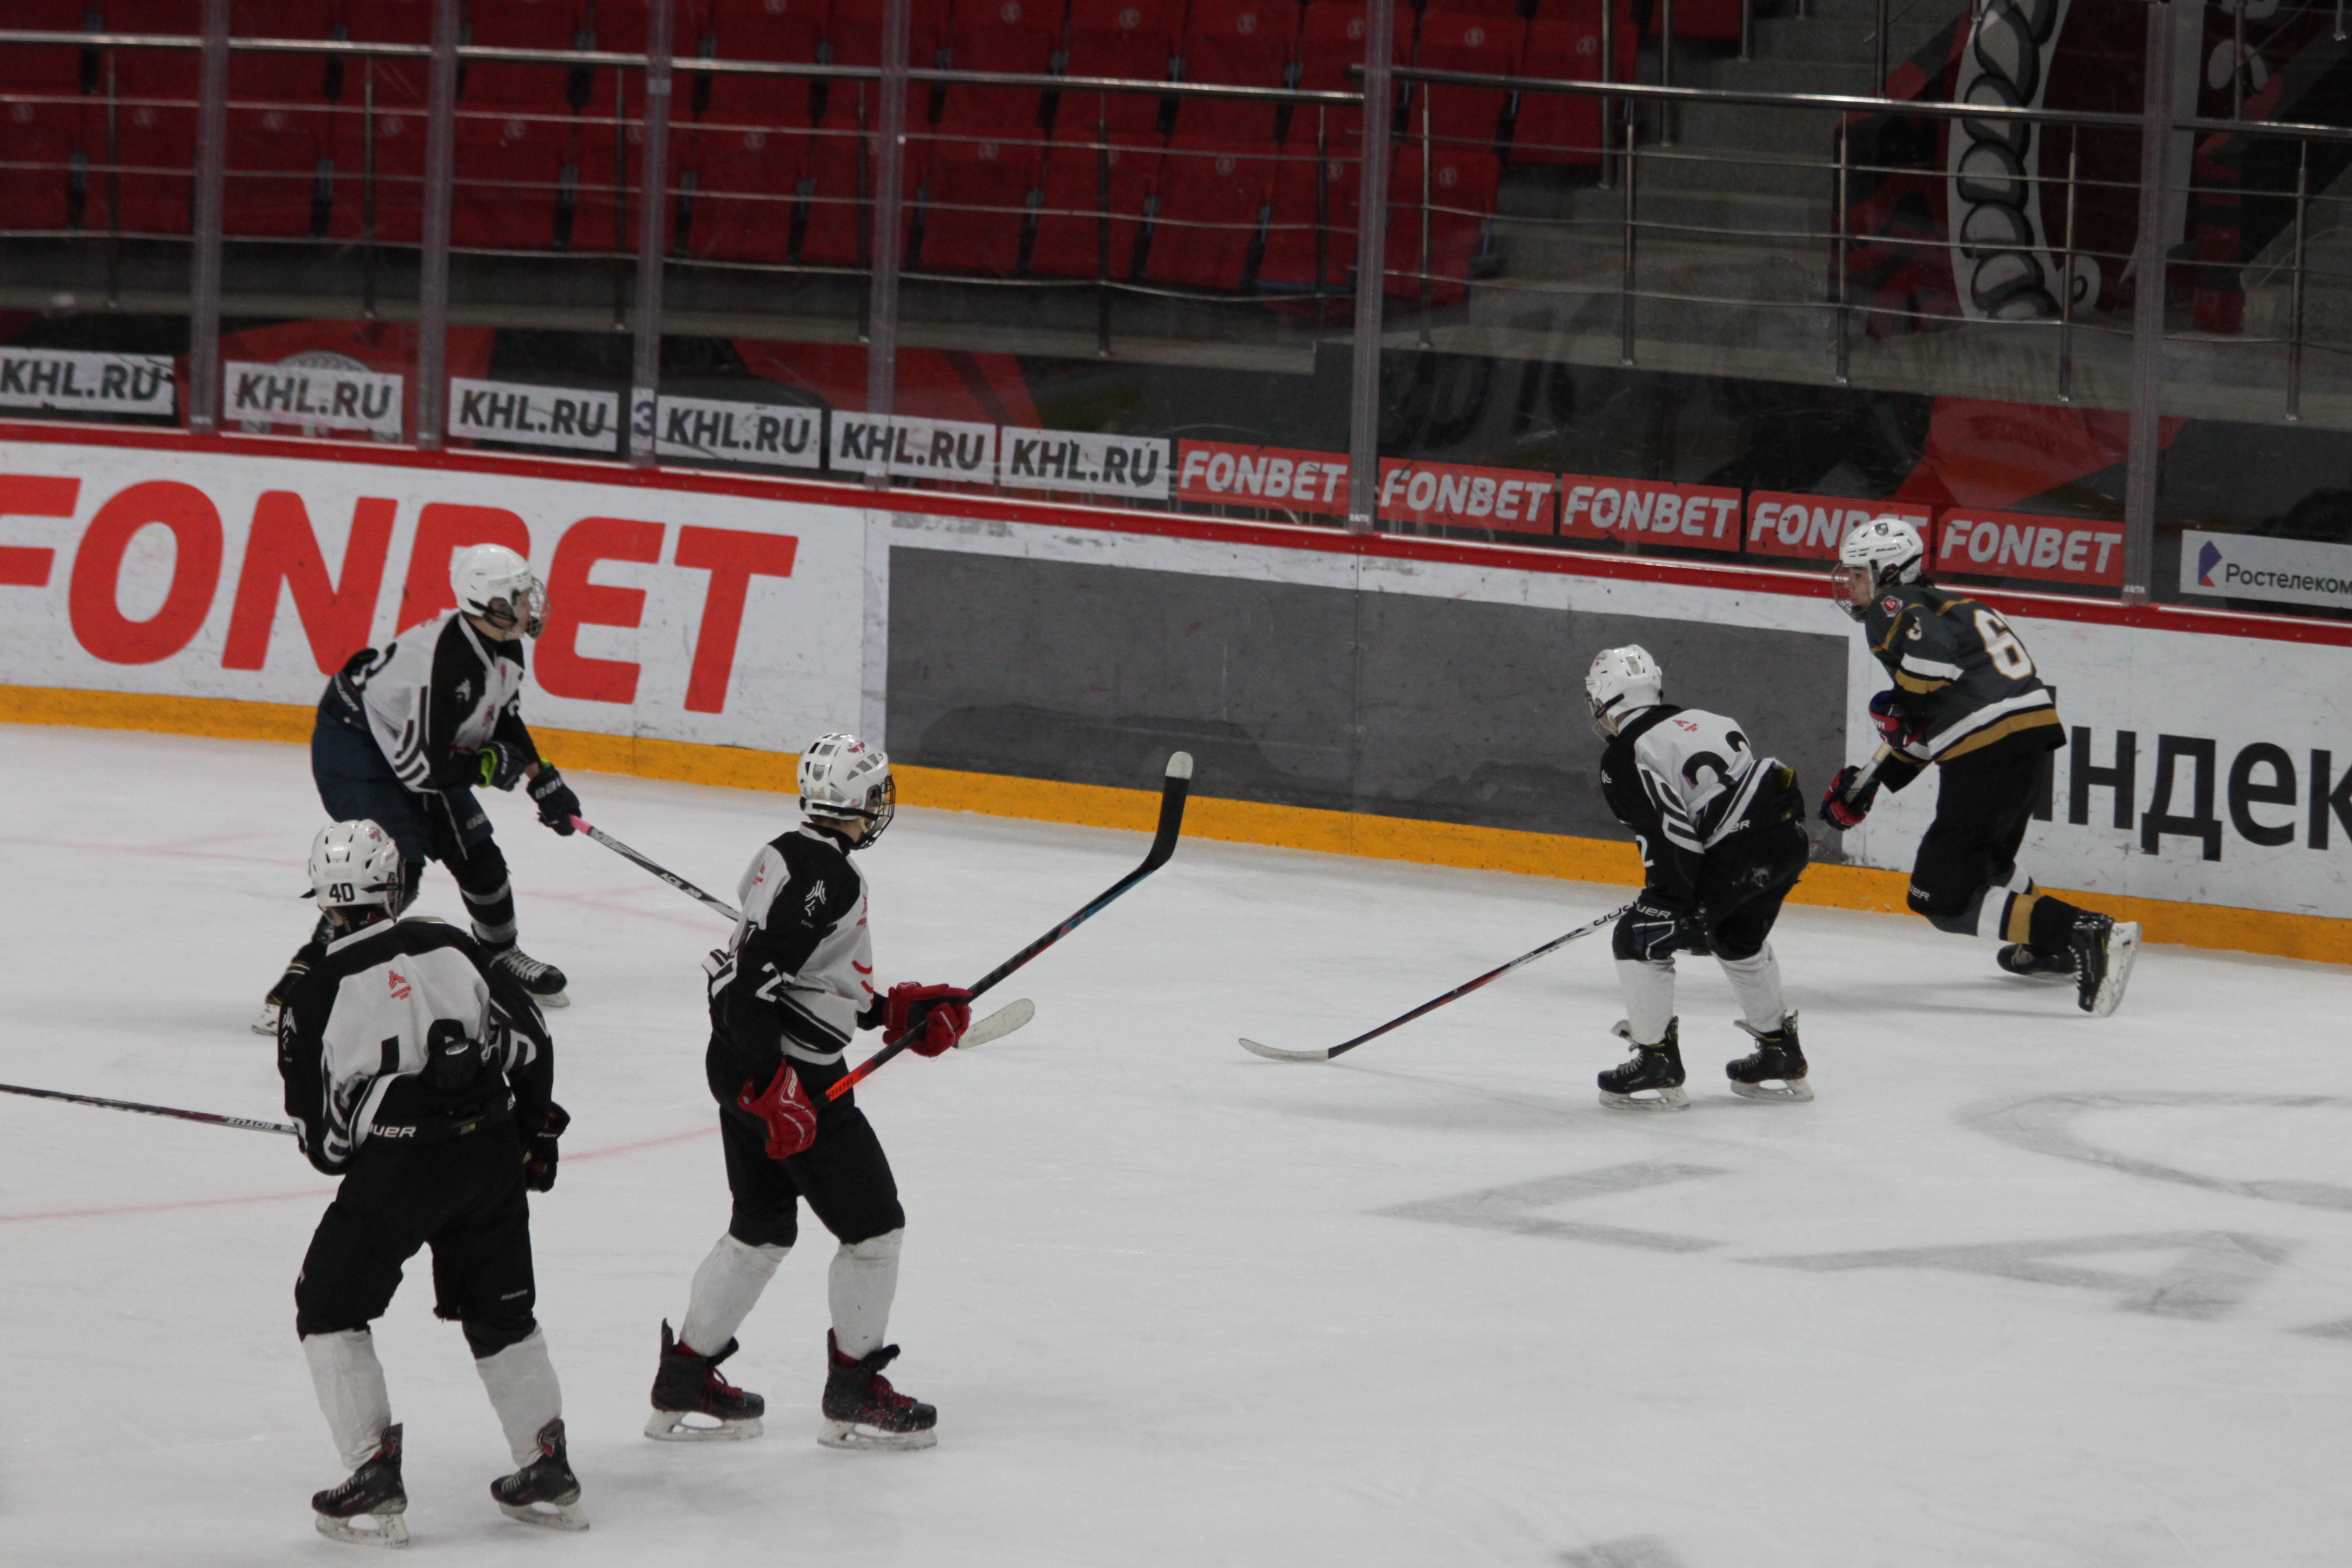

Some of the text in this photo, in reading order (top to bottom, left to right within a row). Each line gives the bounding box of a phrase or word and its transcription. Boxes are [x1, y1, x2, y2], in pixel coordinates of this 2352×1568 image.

[0, 359, 160, 402] KHL.RU
[235, 373, 391, 419] KHL.RU
[457, 390, 605, 438] KHL.RU
[666, 407, 811, 454] KHL.RU
[840, 423, 986, 470] KHL.RU
[1009, 440, 1161, 487] KHL.RU
[1180, 450, 1348, 503] FONBET
[1380, 468, 1552, 521] FONBET
[1563, 487, 1739, 538] FONBET
[1940, 520, 2121, 573] FONBET
[2225, 562, 2352, 595] Ростелеком
[329, 882, 355, 903] 40
